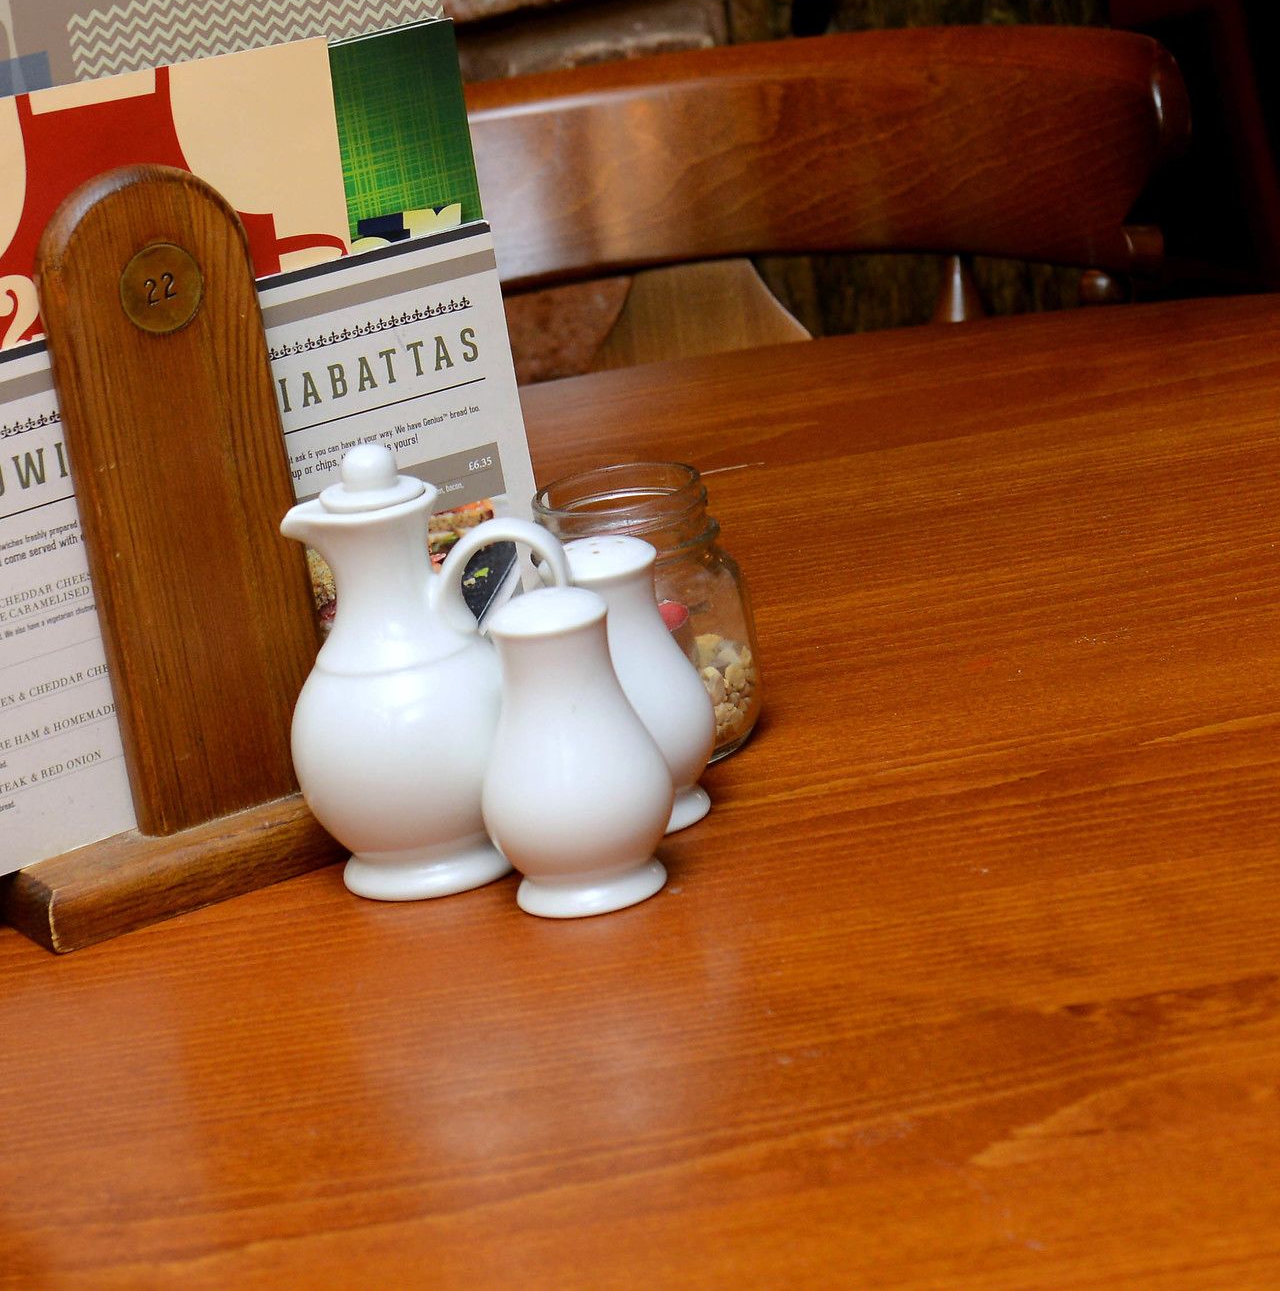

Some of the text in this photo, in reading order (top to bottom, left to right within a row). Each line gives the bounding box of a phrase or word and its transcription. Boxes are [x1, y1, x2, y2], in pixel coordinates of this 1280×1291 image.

[143, 272, 177, 306] 22
[278, 327, 480, 413] IABATTAS
[295, 453, 306, 463] ask
[315, 448, 327, 459] you
[328, 444, 340, 454] can
[340, 439, 356, 450] have
[363, 434, 377, 444] your
[395, 425, 406, 434] We
[407, 421, 422, 431] have
[449, 407, 468, 419] bread
[394, 433, 419, 452] yours!
[291, 469, 303, 480] up
[304, 465, 313, 475] or
[468, 456, 493, 471] £6.35
[49, 519, 78, 539] prepared
[4, 551, 27, 565] come
[29, 539, 57, 558] served
[58, 533, 78, 548] with
[56, 571, 90, 590] CHEES
[9, 585, 90, 619] CARAMELISED
[29, 672, 83, 697] CHEDDAR
[15, 729, 40, 745] HAM
[41, 765, 64, 779] RED
[66, 749, 102, 769] ONION
